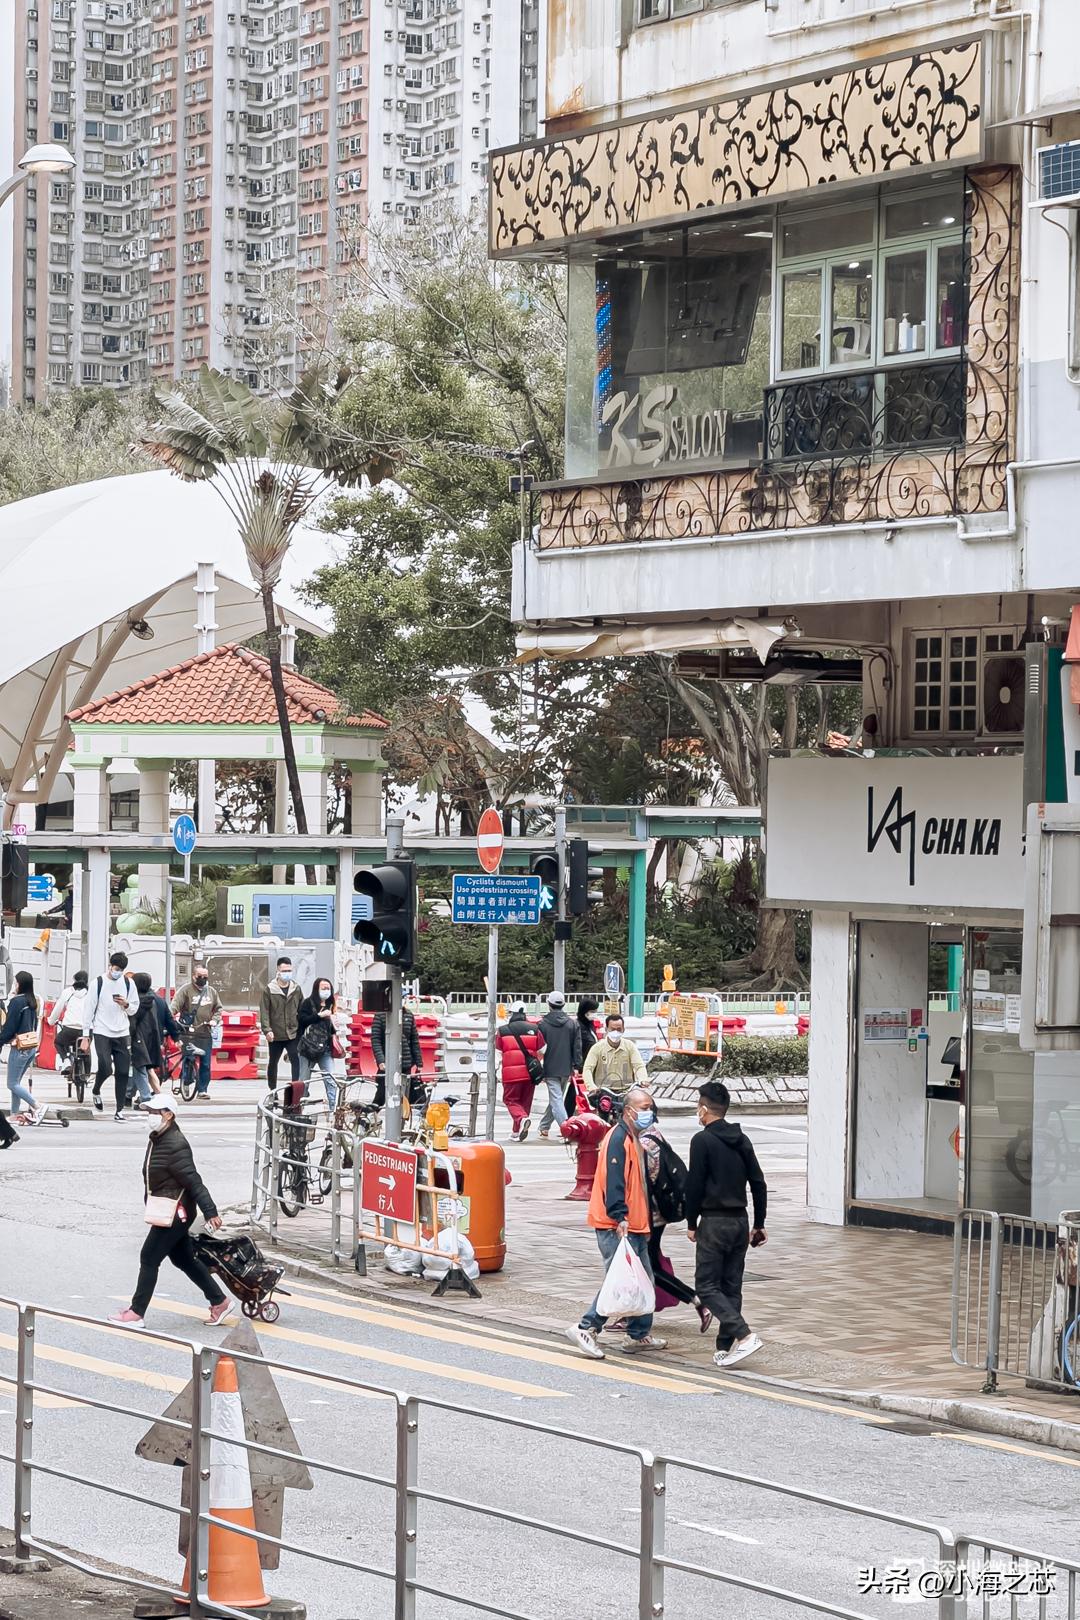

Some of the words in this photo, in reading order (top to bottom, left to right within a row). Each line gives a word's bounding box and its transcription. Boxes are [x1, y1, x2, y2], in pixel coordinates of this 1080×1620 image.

[669, 409, 727, 460] SALON
[466, 877, 494, 886] Cyclists
[495, 878, 528, 886] dismount
[471, 886, 508, 894] pedestrian
[509, 888, 538, 896] crossing
[364, 1151, 414, 1175] PEDESTRIANS
[378, 1194, 395, 1213] 行人
